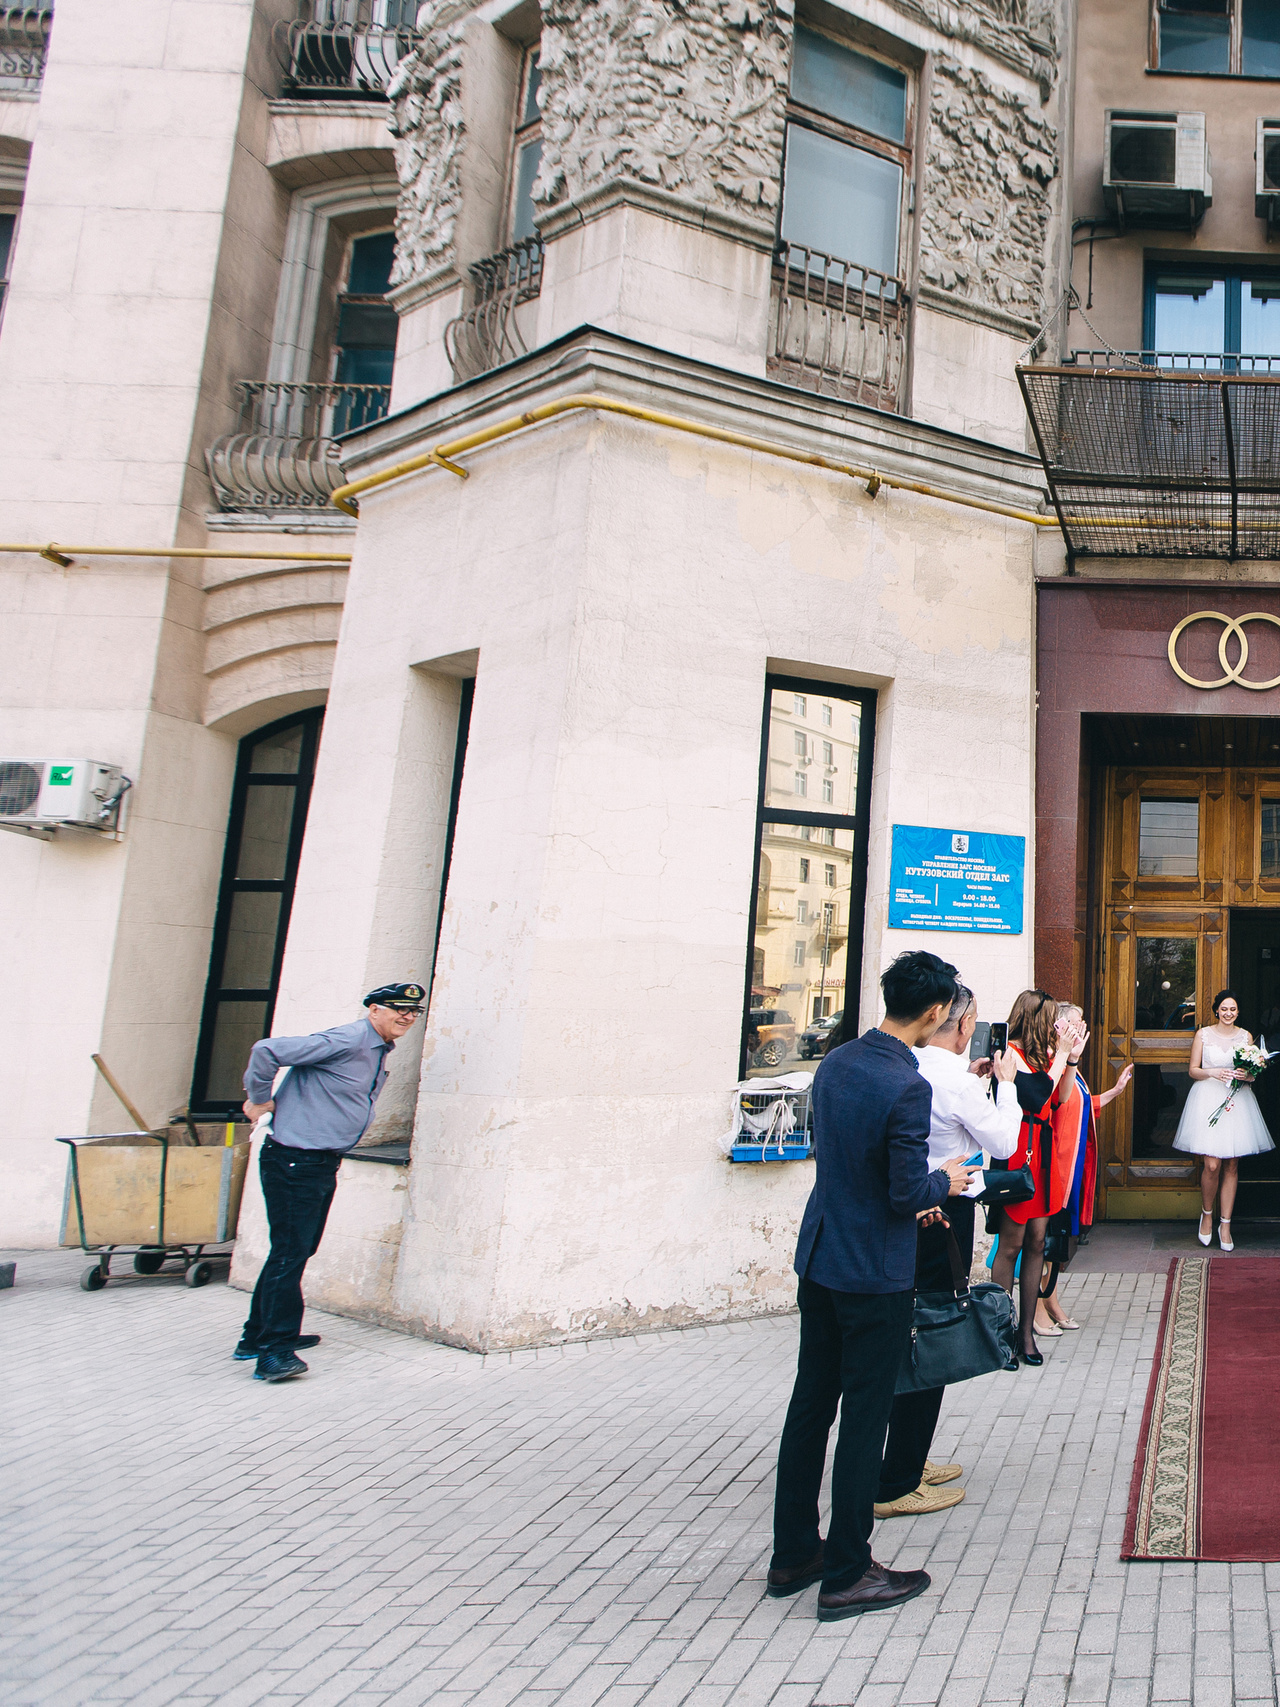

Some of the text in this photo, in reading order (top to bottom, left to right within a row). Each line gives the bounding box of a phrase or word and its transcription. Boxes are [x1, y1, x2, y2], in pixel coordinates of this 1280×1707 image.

[922, 860, 959, 870] УПРАВЛЕНИЕ
[973, 864, 997, 872] МОСКВЫ
[905, 866, 1010, 882] КУТУЗОВСКИЙ ОТДЕЛ ЗАГС
